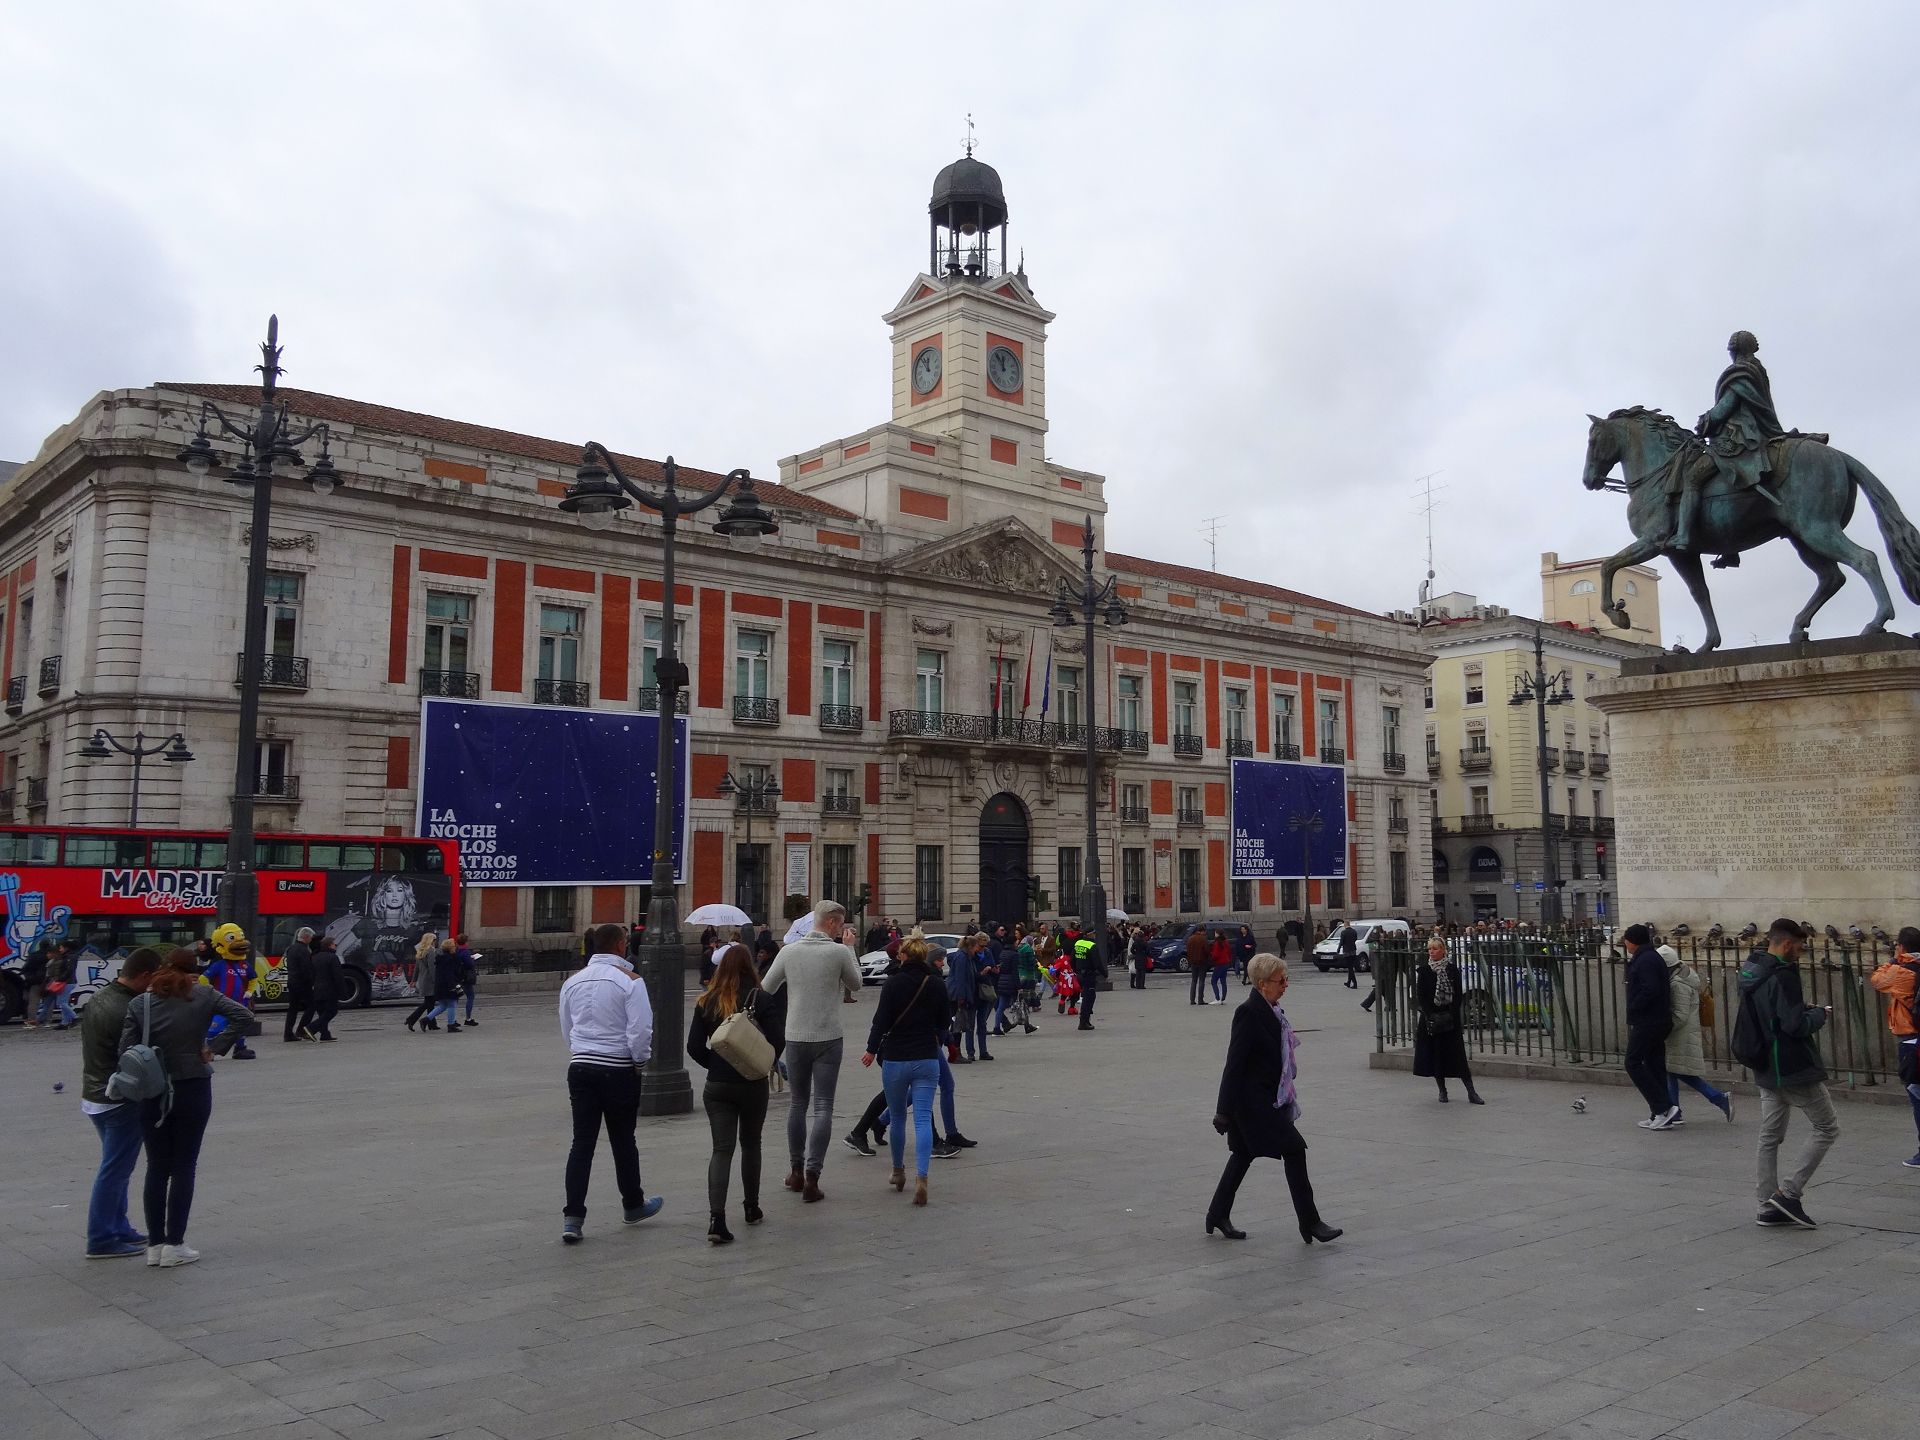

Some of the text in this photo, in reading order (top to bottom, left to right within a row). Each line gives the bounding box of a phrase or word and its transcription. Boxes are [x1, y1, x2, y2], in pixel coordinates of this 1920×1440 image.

[430, 808, 457, 822] LA
[429, 824, 497, 838] NOCHE
[1236, 828, 1248, 838] LA
[460, 840, 497, 854] LOS
[1236, 839, 1265, 848] NOCHE
[1236, 849, 1265, 858] DE LOS
[459, 855, 517, 869] ATROS
[1236, 859, 1274, 868] TEATROS
[465, 870, 517, 880] RZO 2017
[145, 892, 183, 912] City
